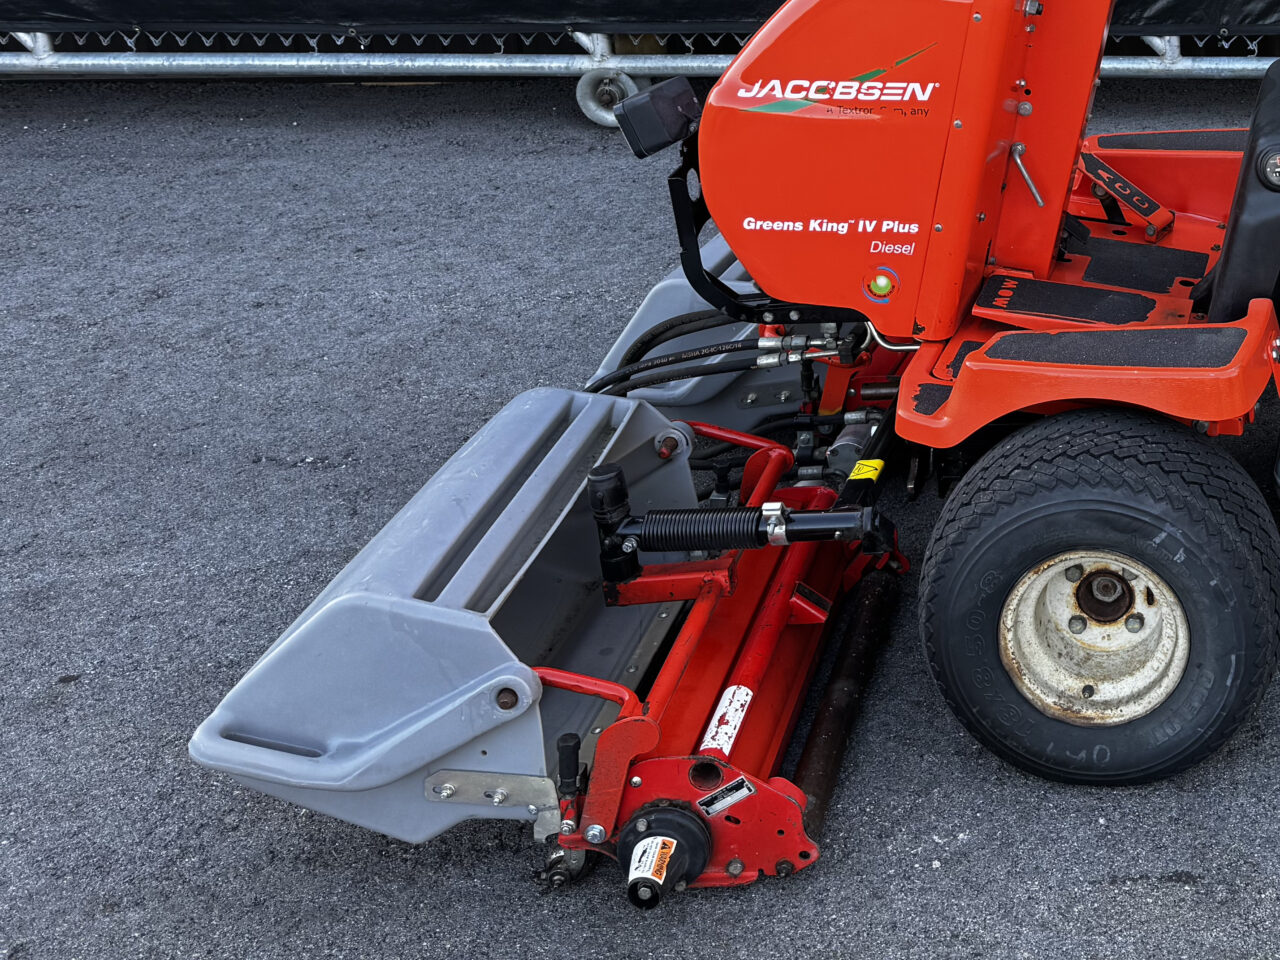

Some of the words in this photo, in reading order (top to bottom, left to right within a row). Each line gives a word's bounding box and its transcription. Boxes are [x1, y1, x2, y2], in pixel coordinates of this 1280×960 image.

[742, 217, 804, 232] Greens
[857, 219, 878, 233] IV
[881, 220, 920, 235] Plus
[869, 240, 916, 256] Diesel
[992, 278, 1019, 308] MOW
